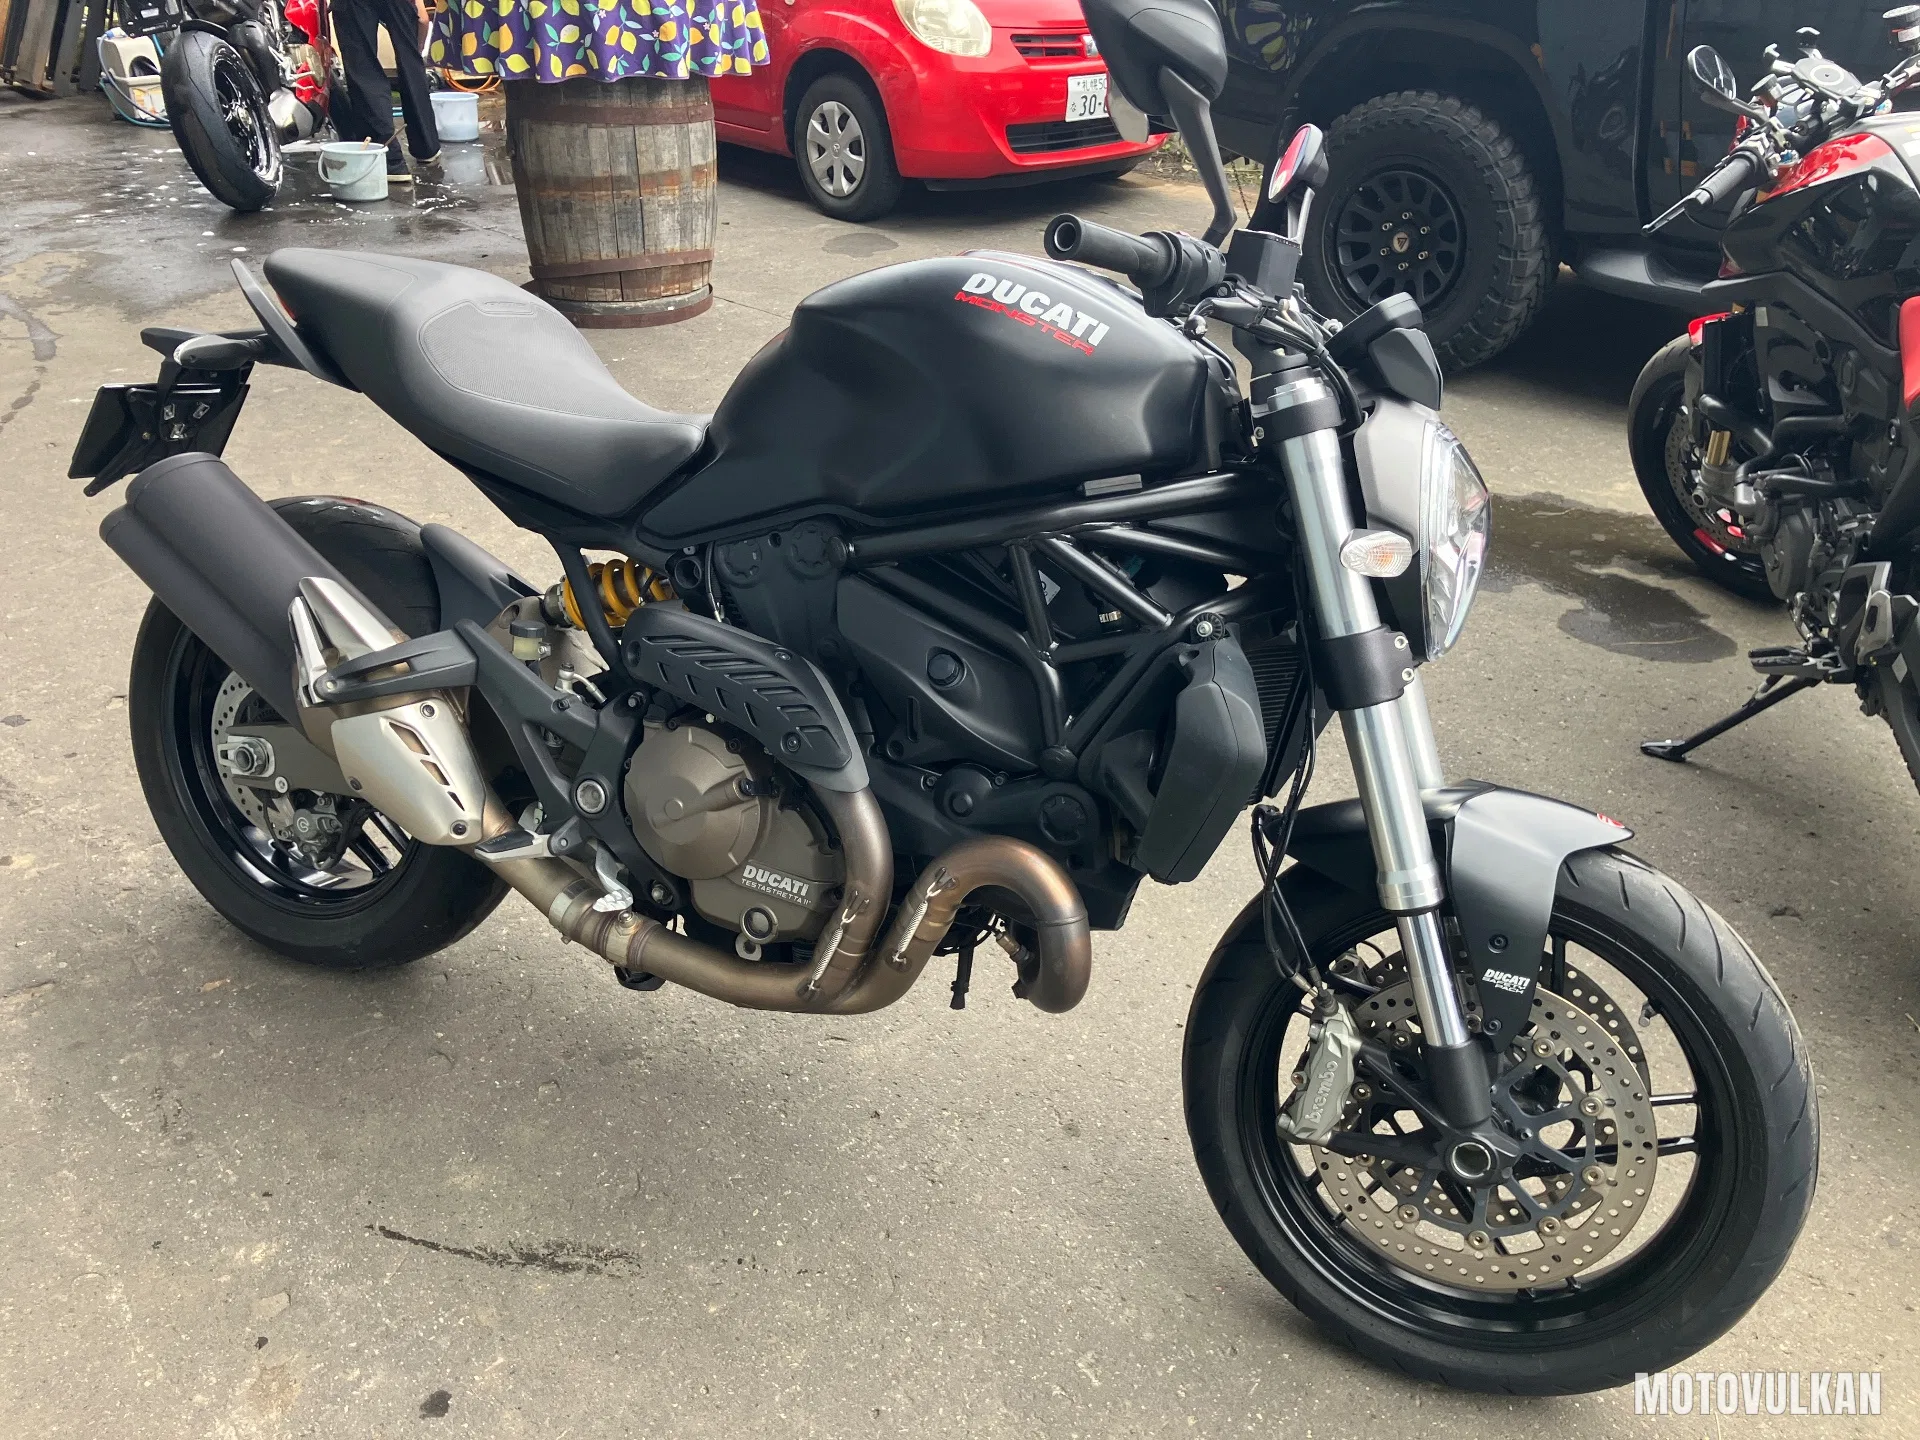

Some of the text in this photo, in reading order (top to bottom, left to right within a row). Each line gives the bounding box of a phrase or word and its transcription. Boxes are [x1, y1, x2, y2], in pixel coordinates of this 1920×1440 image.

[954, 291, 1095, 356] MONSTER
[962, 273, 1110, 346] DUCATI
[741, 877, 802, 904] TESTASTRETTA
[743, 864, 809, 896] DUCATI
[1483, 968, 1531, 988] DUCATI
[1304, 1061, 1339, 1124] brembo
